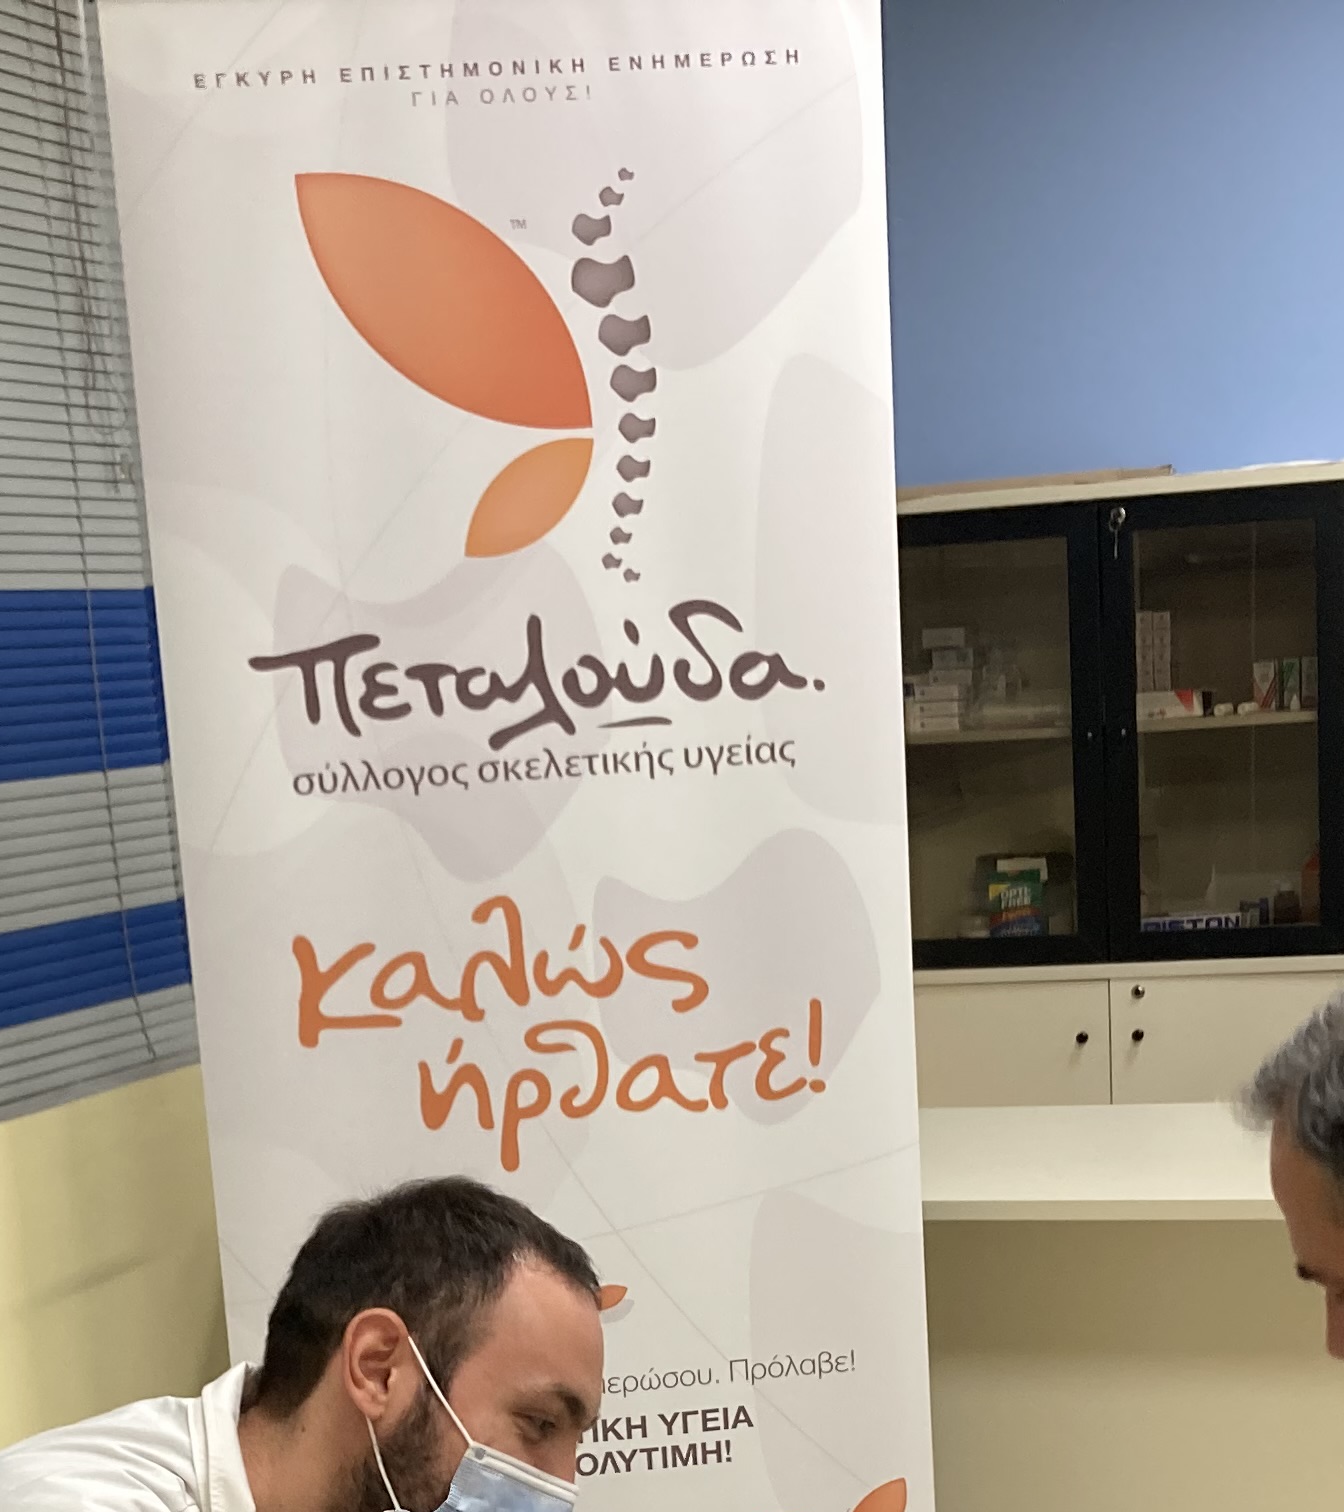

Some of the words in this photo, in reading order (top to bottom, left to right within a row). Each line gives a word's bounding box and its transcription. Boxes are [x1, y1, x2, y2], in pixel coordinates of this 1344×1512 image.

[193, 68, 317, 89] ΕΓΚΥΡΗ
[339, 57, 586, 84] ΕΠΙΣΤΗΜΟΝΙΚΗ
[608, 48, 800, 72] ΕΝΗΜΕΡΩΣΗ
[411, 89, 459, 107] ΓΙΑ
[479, 84, 592, 106] ΟΛΟΥΣ!
[292, 759, 470, 797] σύλλογος
[477, 742, 675, 784] σκελετικής
[681, 735, 797, 776] υγείας
[416, 996, 828, 1172] ήρθατε!
[601, 1366, 721, 1398] ερώσου.
[729, 1348, 856, 1386] Πρόλαβε!
[577, 1414, 649, 1445] ΙΚΗ
[657, 1404, 755, 1437] ΥΓΕΙΑ
